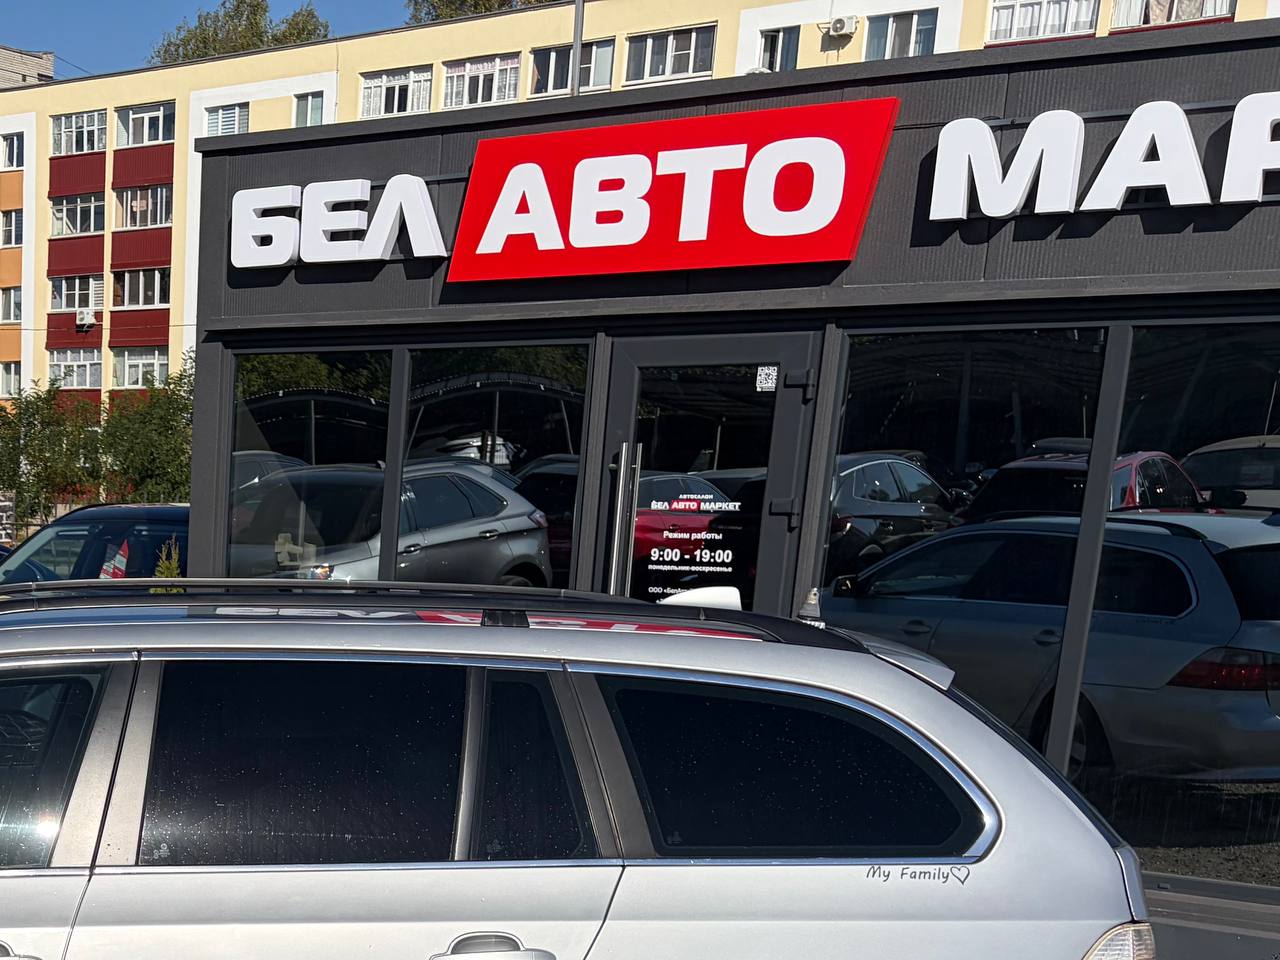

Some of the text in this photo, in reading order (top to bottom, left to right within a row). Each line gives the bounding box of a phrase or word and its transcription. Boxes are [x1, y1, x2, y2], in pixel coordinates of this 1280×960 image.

[231, 173, 448, 269] БЕЛ
[475, 136, 846, 255] АВТО
[651, 500, 741, 511] БЕЛ АВТО МАРКЕТ
[663, 531, 723, 541] Режим работы
[650, 548, 680, 561] 9:00
[694, 549, 733, 562] 19:00
[866, 865, 950, 884] My Family
